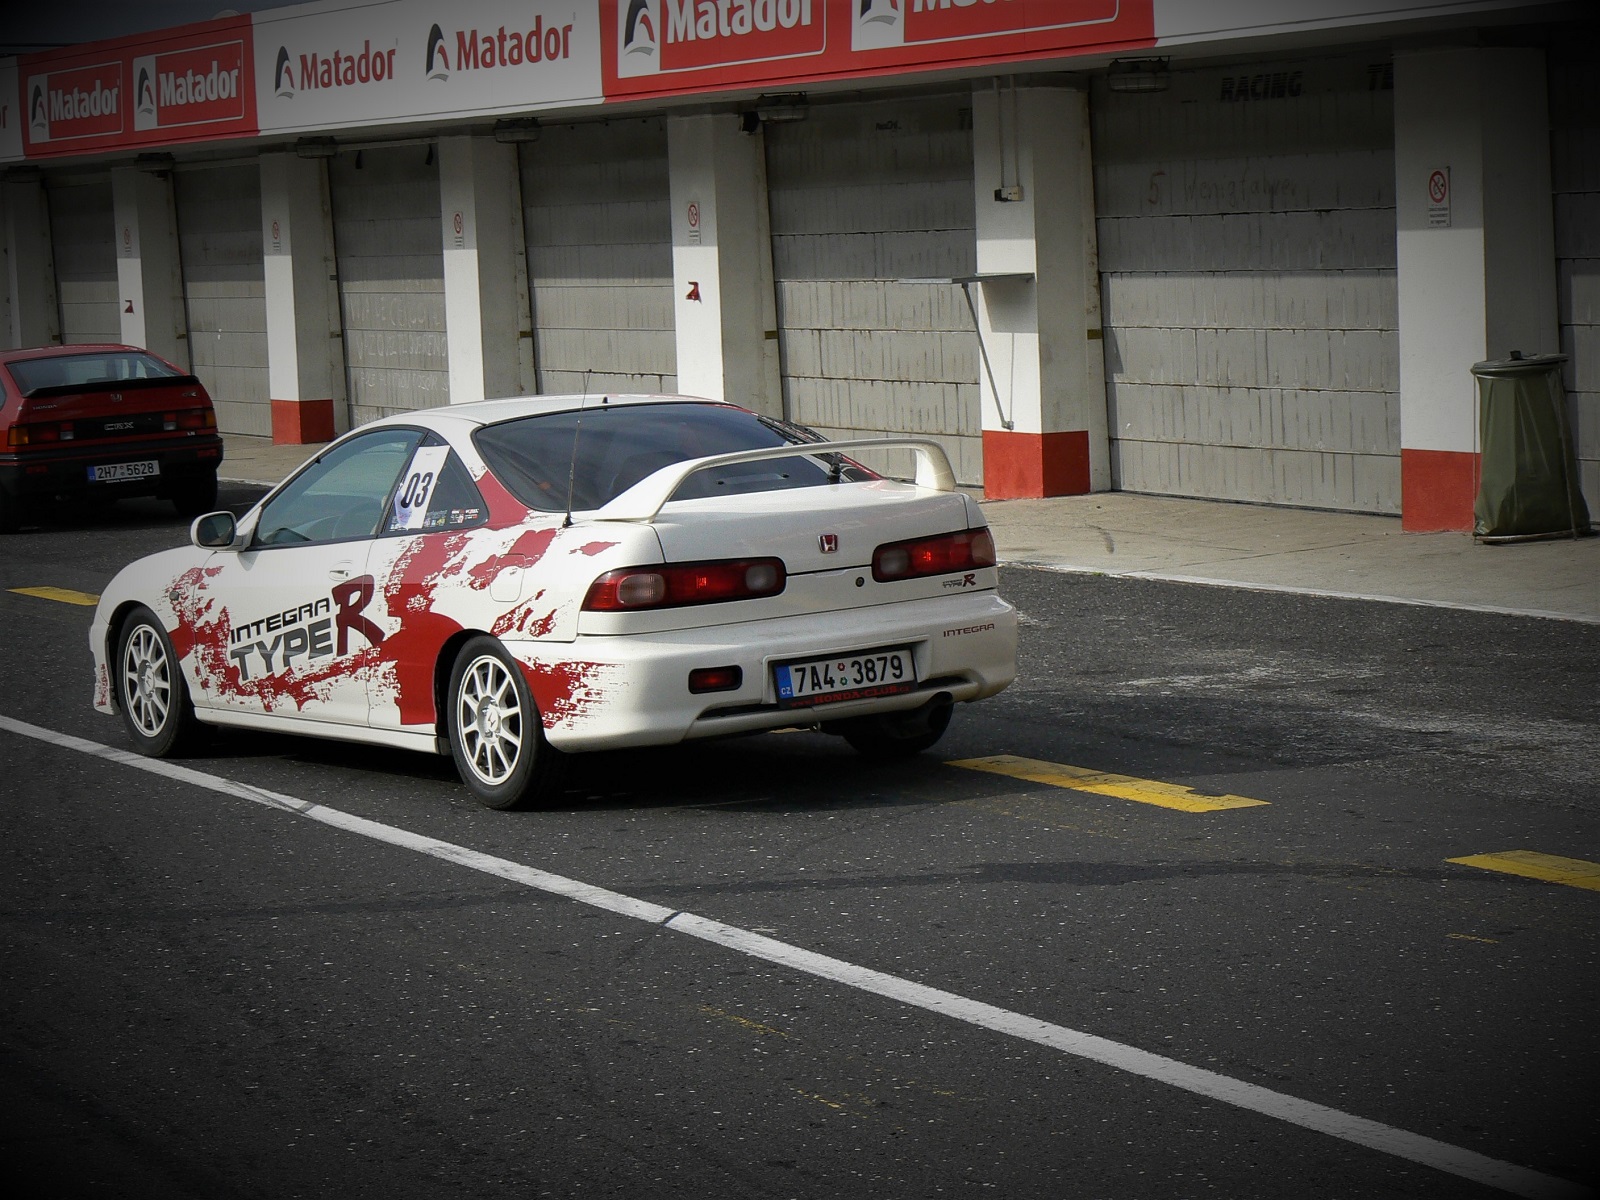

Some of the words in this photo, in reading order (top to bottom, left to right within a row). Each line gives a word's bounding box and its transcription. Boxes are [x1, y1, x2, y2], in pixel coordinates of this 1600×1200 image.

[456, 15, 573, 70] Matador
[667, 0, 812, 43] Matador
[158, 60, 239, 108] Matador
[299, 40, 396, 91] Matador
[1220, 71, 1303, 102] RACING
[49, 78, 119, 122] Matador
[97, 466, 118, 479] 2H7
[126, 463, 154, 476] 5628
[401, 472, 433, 509] 03
[230, 598, 331, 644] INTEGRA
[230, 621, 333, 681] TYPE
[331, 574, 385, 656] R
[943, 623, 995, 638] INTEGRA
[781, 686, 791, 695] CZ
[794, 664, 836, 693] 7A4
[851, 655, 903, 685] 3879
